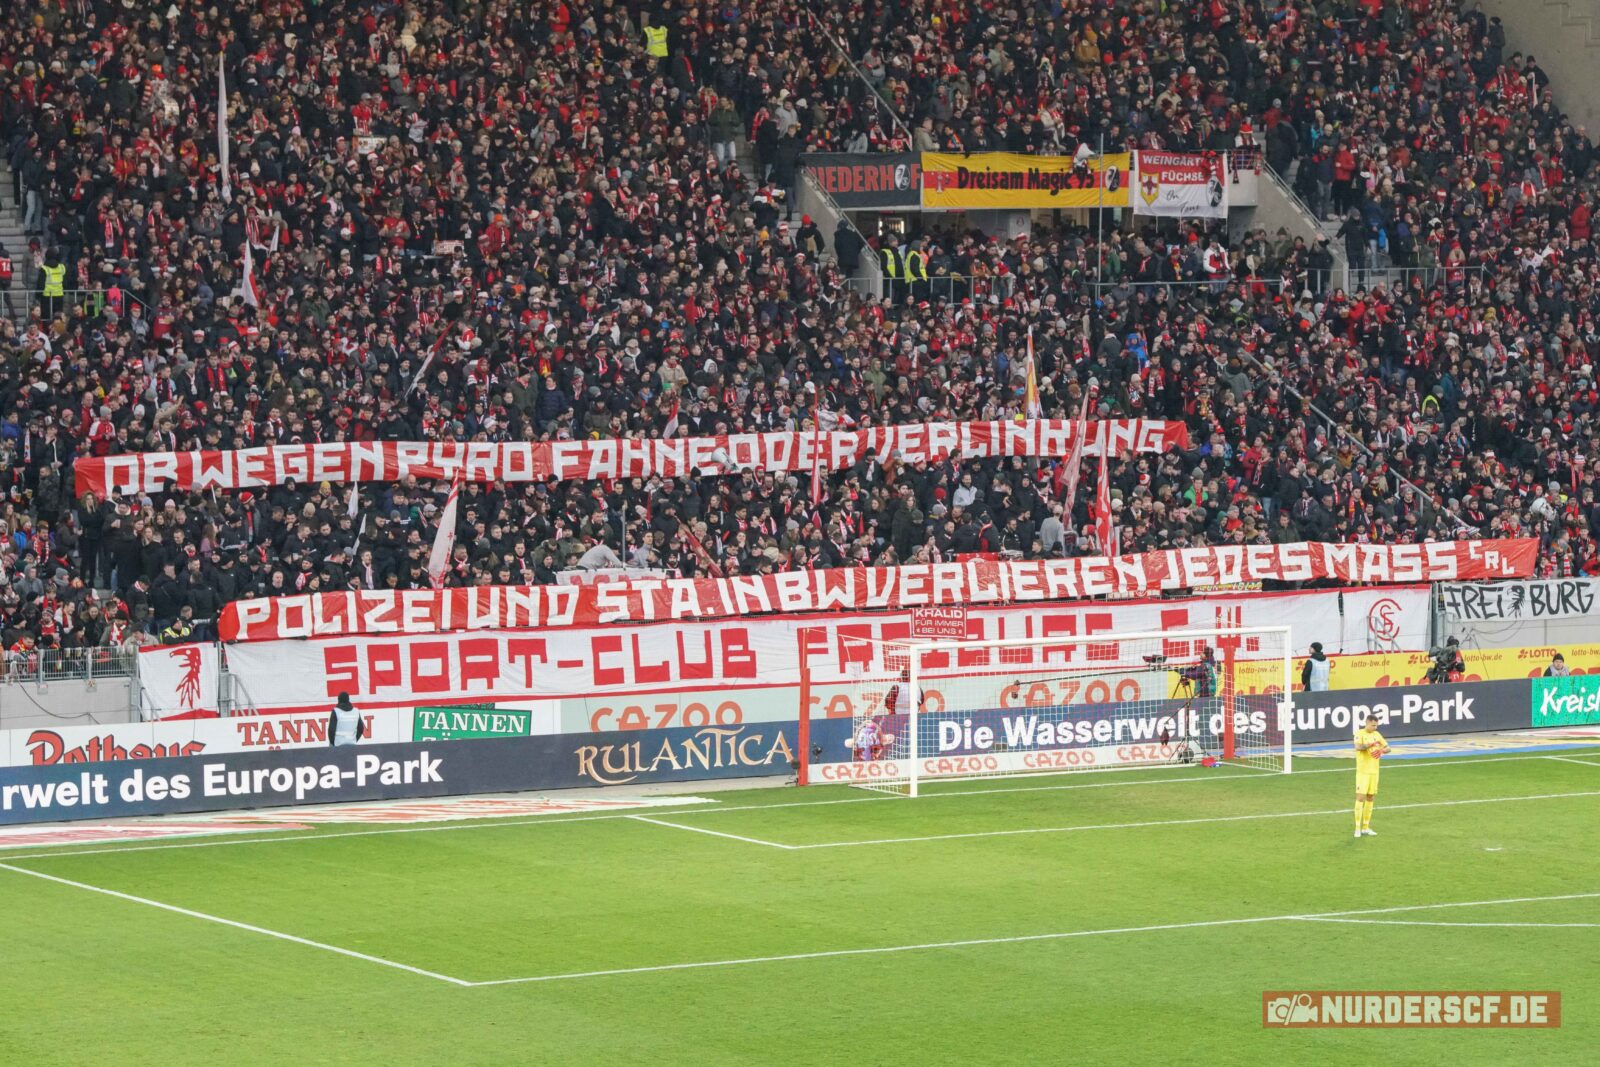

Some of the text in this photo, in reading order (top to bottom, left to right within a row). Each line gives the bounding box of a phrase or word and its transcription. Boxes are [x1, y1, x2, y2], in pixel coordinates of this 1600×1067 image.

[957, 166, 1024, 190] Dreisam
[1028, 167, 1073, 196] Magic
[1161, 169, 1205, 182] FÜCHSE
[104, 452, 177, 498] OB
[191, 441, 384, 489] WEGEN
[552, 437, 719, 481] FAHNE
[727, 430, 859, 473] ODER
[867, 418, 1166, 465] VERLINKUNG
[236, 588, 451, 640] POLIZEI
[466, 584, 580, 630] UND
[717, 575, 772, 615] IN
[774, 567, 855, 611] BW
[866, 552, 1150, 608] VERLIEREN
[1161, 541, 1313, 590] JEDES
[1320, 540, 1458, 582] MASS
[1530, 581, 1594, 617] BURG
[914, 618, 963, 627] FÜR IMMER
[915, 608, 963, 619] KHALID
[324, 627, 757, 698] SPORT-CLUB
[1351, 658, 1391, 669] lotto-bw.de
[1464, 653, 1503, 663] lotto-bw.de
[1529, 648, 1558, 659] LOTTO
[419, 711, 526, 734] TANNEN
[591, 700, 743, 734] CAZOO
[939, 691, 1475, 752] Die Wasserwelt des Europa-Park
[237, 715, 375, 747] TANNN
[574, 724, 799, 785] RULANTICA
[923, 756, 999, 775] CAZOO
[1022, 750, 1096, 769] CAZOO
[2, 750, 444, 810] rwelt des Europa-Park
[821, 762, 900, 781] CAZOO
